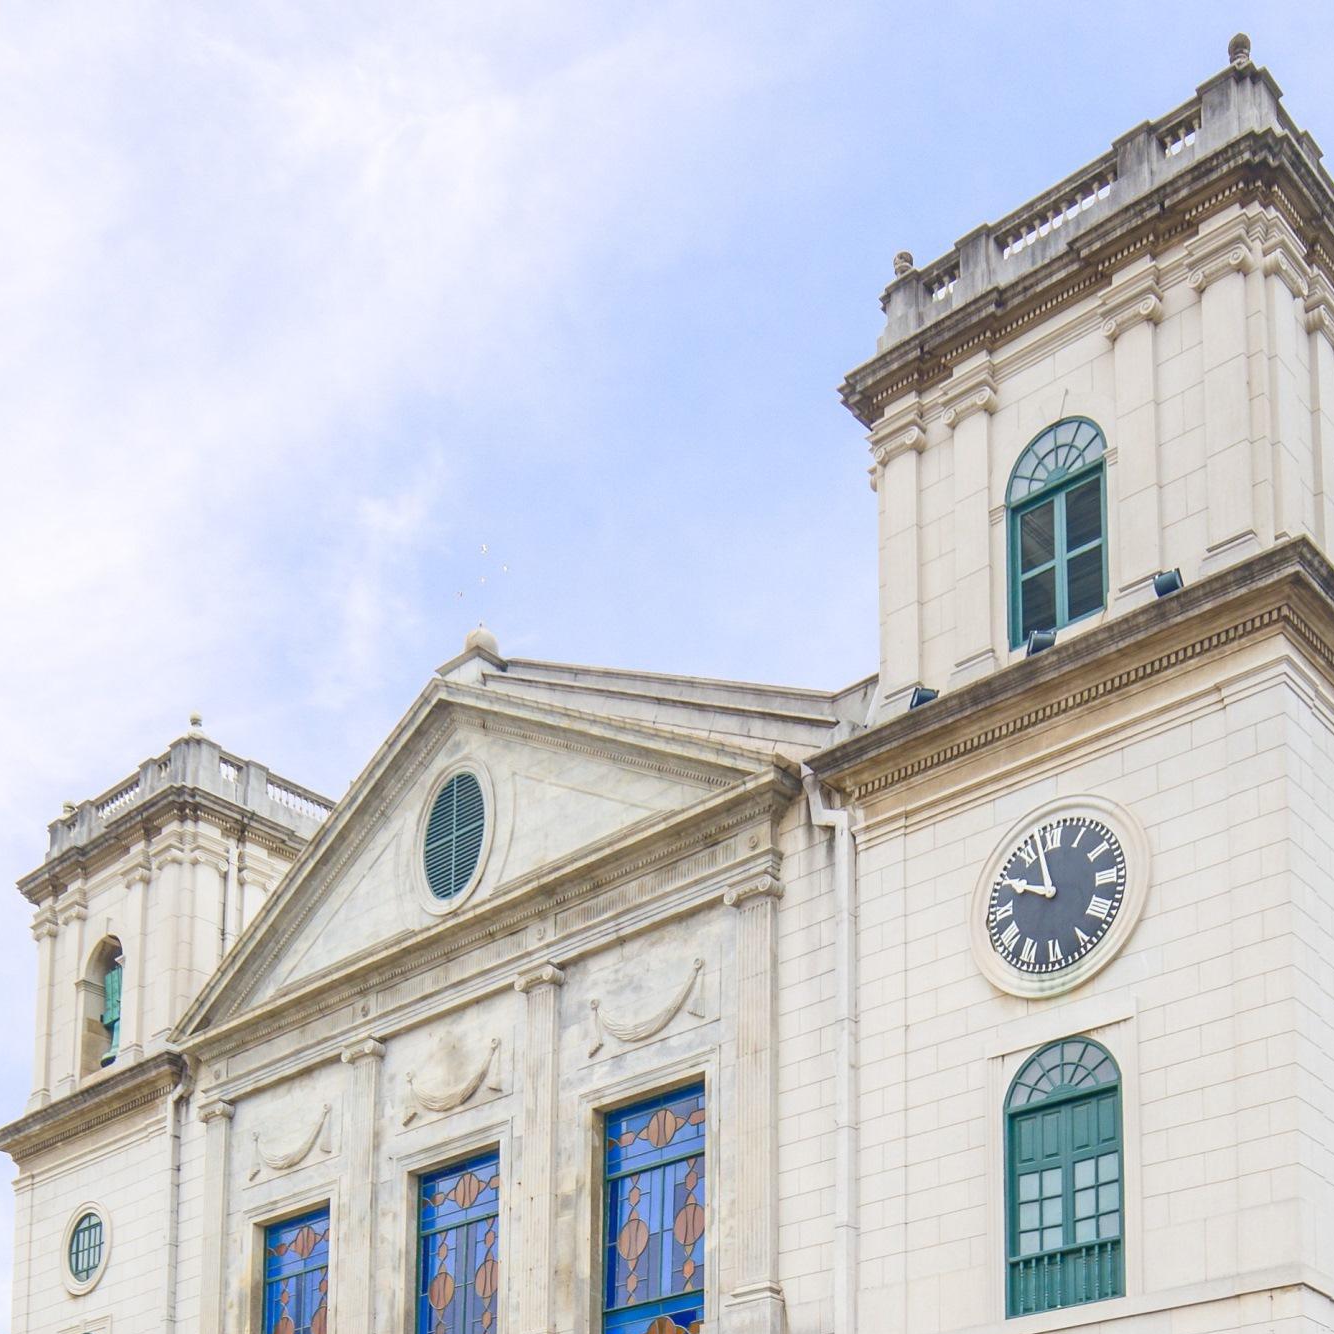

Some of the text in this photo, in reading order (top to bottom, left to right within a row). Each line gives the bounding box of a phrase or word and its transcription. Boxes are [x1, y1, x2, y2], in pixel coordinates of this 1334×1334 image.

[1044, 826, 1063, 852] XII
[1071, 827, 1087, 848] I
[1019, 844, 1038, 868] XI
[1087, 841, 1109, 862] II
[1095, 865, 1118, 887] III
[996, 900, 1013, 922] IX
[1086, 894, 1113, 920] IIII
[1000, 920, 1021, 952] VIII
[1074, 926, 1090, 946] V
[1019, 937, 1037, 963] VII
[1048, 938, 1063, 962] VI
